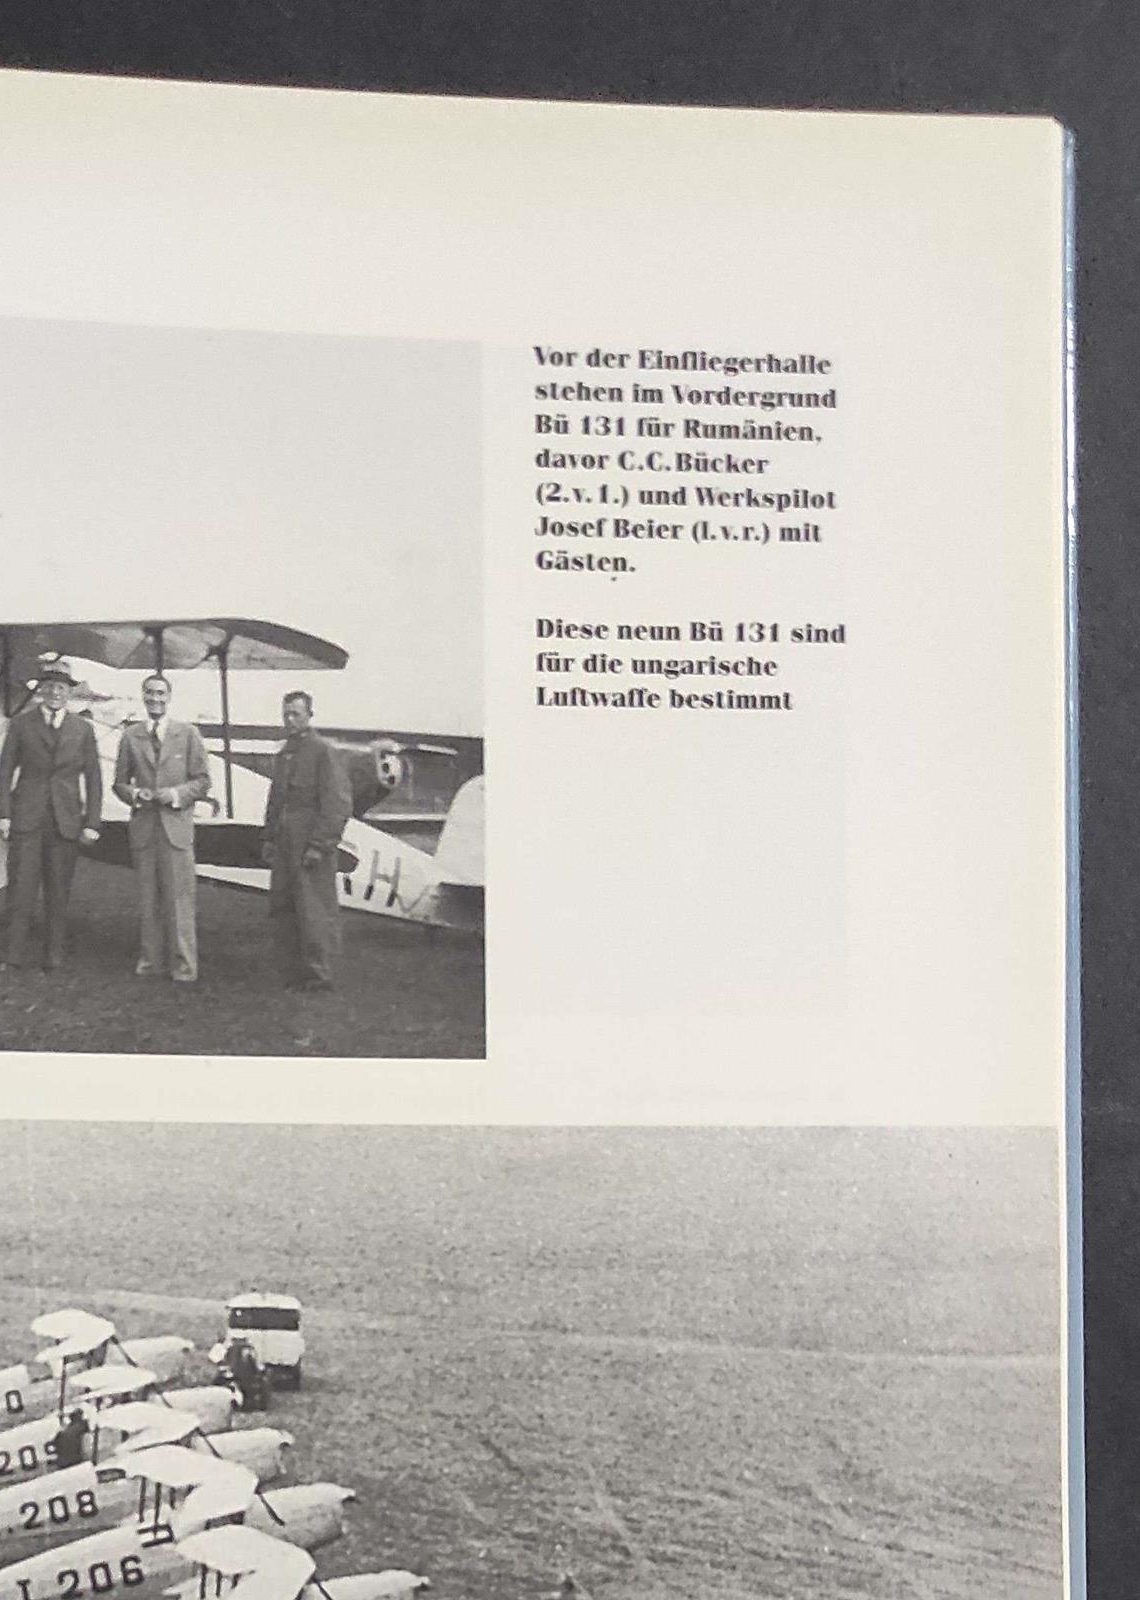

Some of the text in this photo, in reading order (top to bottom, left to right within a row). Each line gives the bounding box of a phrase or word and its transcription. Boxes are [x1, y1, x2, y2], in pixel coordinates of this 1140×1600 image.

[533, 346, 831, 376] Vor der Einfliegerhalle
[535, 382, 836, 410] stehen im Vordergrund
[535, 414, 822, 442] Bü 131 für Rumänien,
[535, 449, 609, 470] davor
[639, 487, 687, 506] und
[695, 487, 836, 512] Werkspilot
[535, 517, 607, 537] Josef
[614, 519, 684, 539] Beier
[780, 523, 821, 542] mit
[536, 550, 636, 573] Gästen.
[537, 619, 845, 643] Diese neun Bü 131 sind
[537, 652, 778, 679] für die ungarische
[537, 687, 792, 710] Luftwaffe bestimmt
